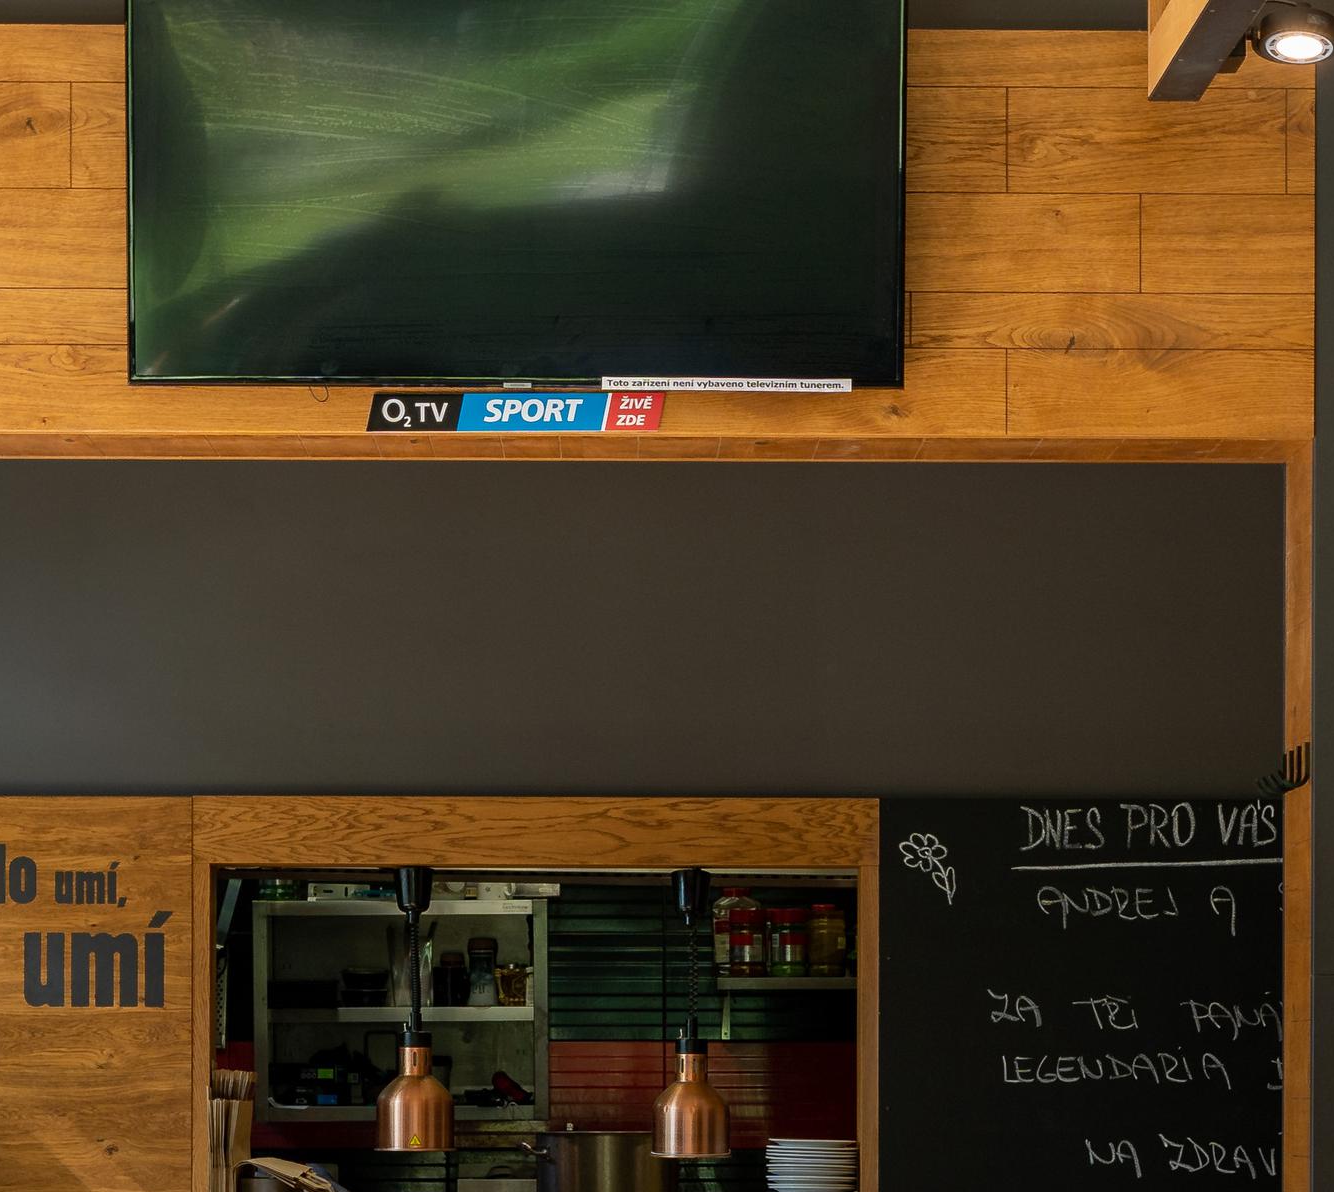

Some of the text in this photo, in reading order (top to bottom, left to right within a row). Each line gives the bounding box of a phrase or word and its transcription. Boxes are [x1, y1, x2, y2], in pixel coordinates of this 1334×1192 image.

[607, 379, 845, 391] Toto zařízení není vybaveno televizním tunerem.
[415, 402, 449, 423] TV
[482, 398, 585, 424] SPORT
[618, 395, 653, 410] ŽIVĚ
[615, 414, 646, 427] ZDE
[1020, 805, 1105, 851] DNES
[1120, 801, 1197, 849] PRO
[54, 861, 128, 909] umí,
[1037, 885, 1179, 929] ANDREJ
[1210, 885, 1236, 937] A
[23, 910, 174, 1008] umí
[987, 989, 1042, 1028] ZA
[1085, 1138, 1142, 1179] NA
